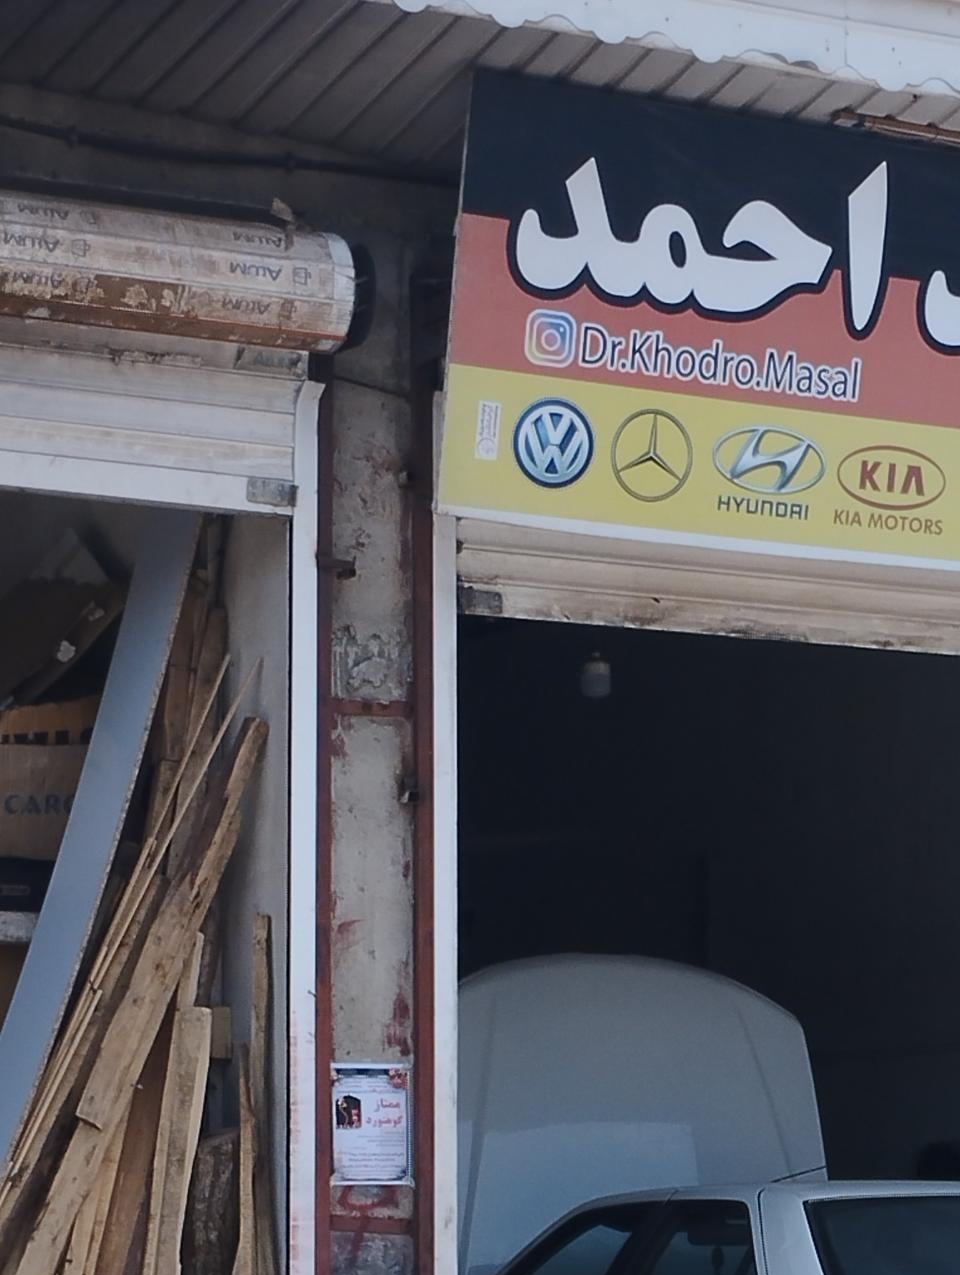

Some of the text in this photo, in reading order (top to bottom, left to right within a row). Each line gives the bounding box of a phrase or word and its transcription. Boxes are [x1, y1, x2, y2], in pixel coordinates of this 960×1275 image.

[515, 156, 889, 332] احمد
[580, 324, 862, 402] Dr.Khodro.Masal
[858, 459, 926, 498] KIA
[717, 495, 810, 521] HYUNDAI
[832, 509, 944, 536] KIA MOTORS
